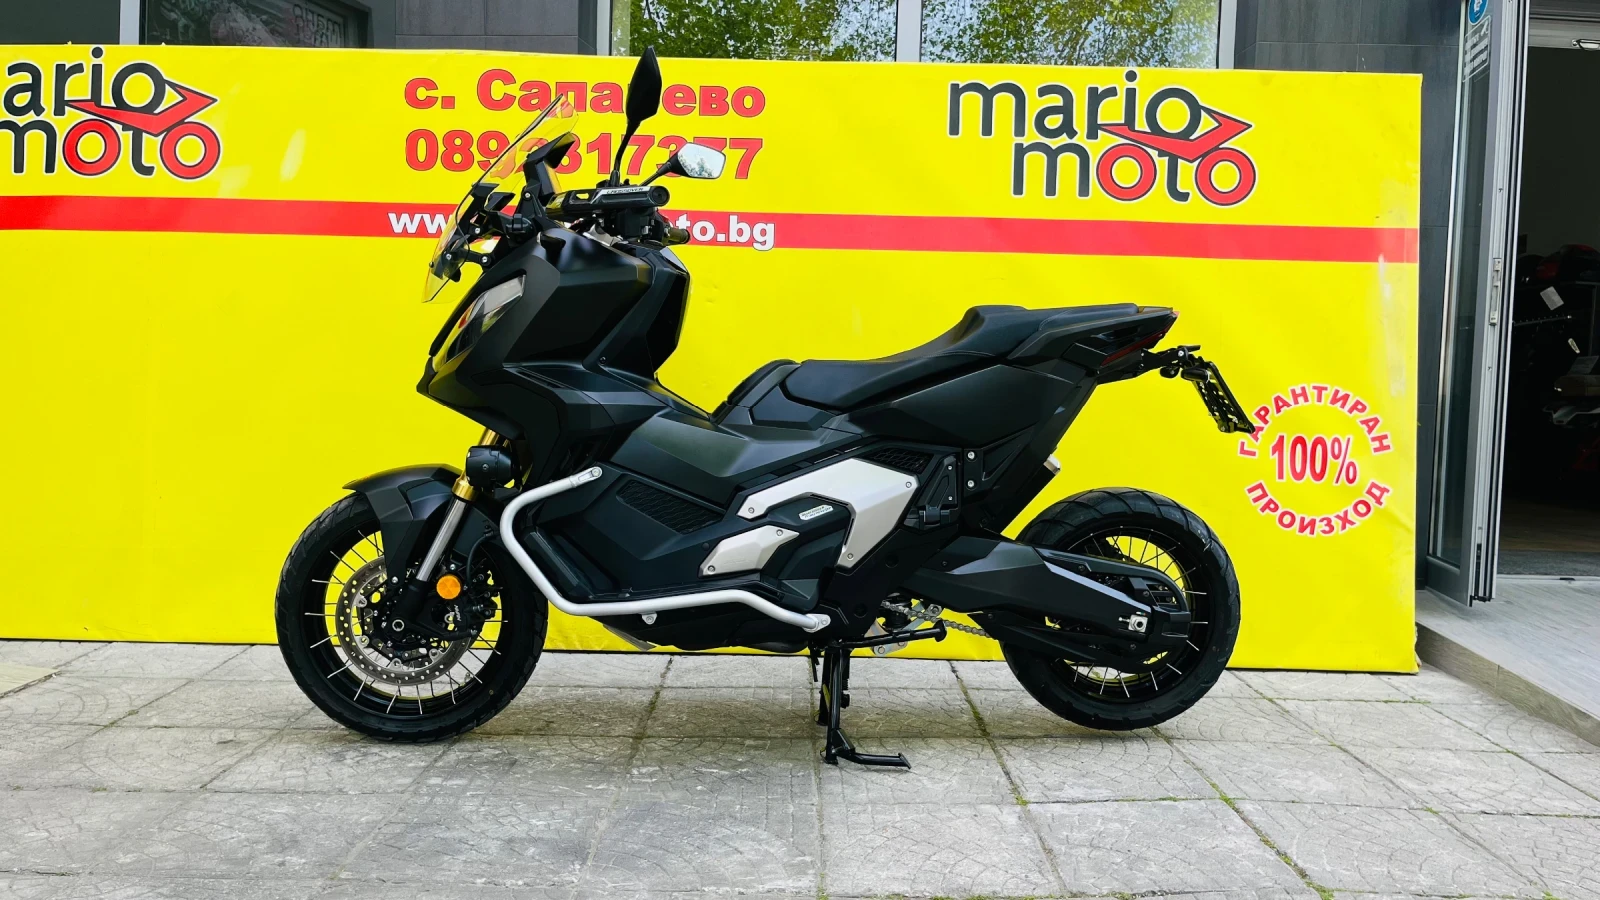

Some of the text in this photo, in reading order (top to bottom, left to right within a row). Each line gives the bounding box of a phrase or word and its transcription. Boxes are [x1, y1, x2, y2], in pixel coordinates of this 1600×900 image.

[3, 46, 166, 117] ario
[405, 68, 766, 117] с. Сапаево
[948, 70, 1202, 140] mario
[0, 118, 221, 180] moto
[1013, 140, 1256, 206] moto
[1239, 385, 1391, 457] ГАРАНТИРАН
[1271, 434, 1357, 485] 100%
[1246, 481, 1391, 536] ПРОИЗХОД
